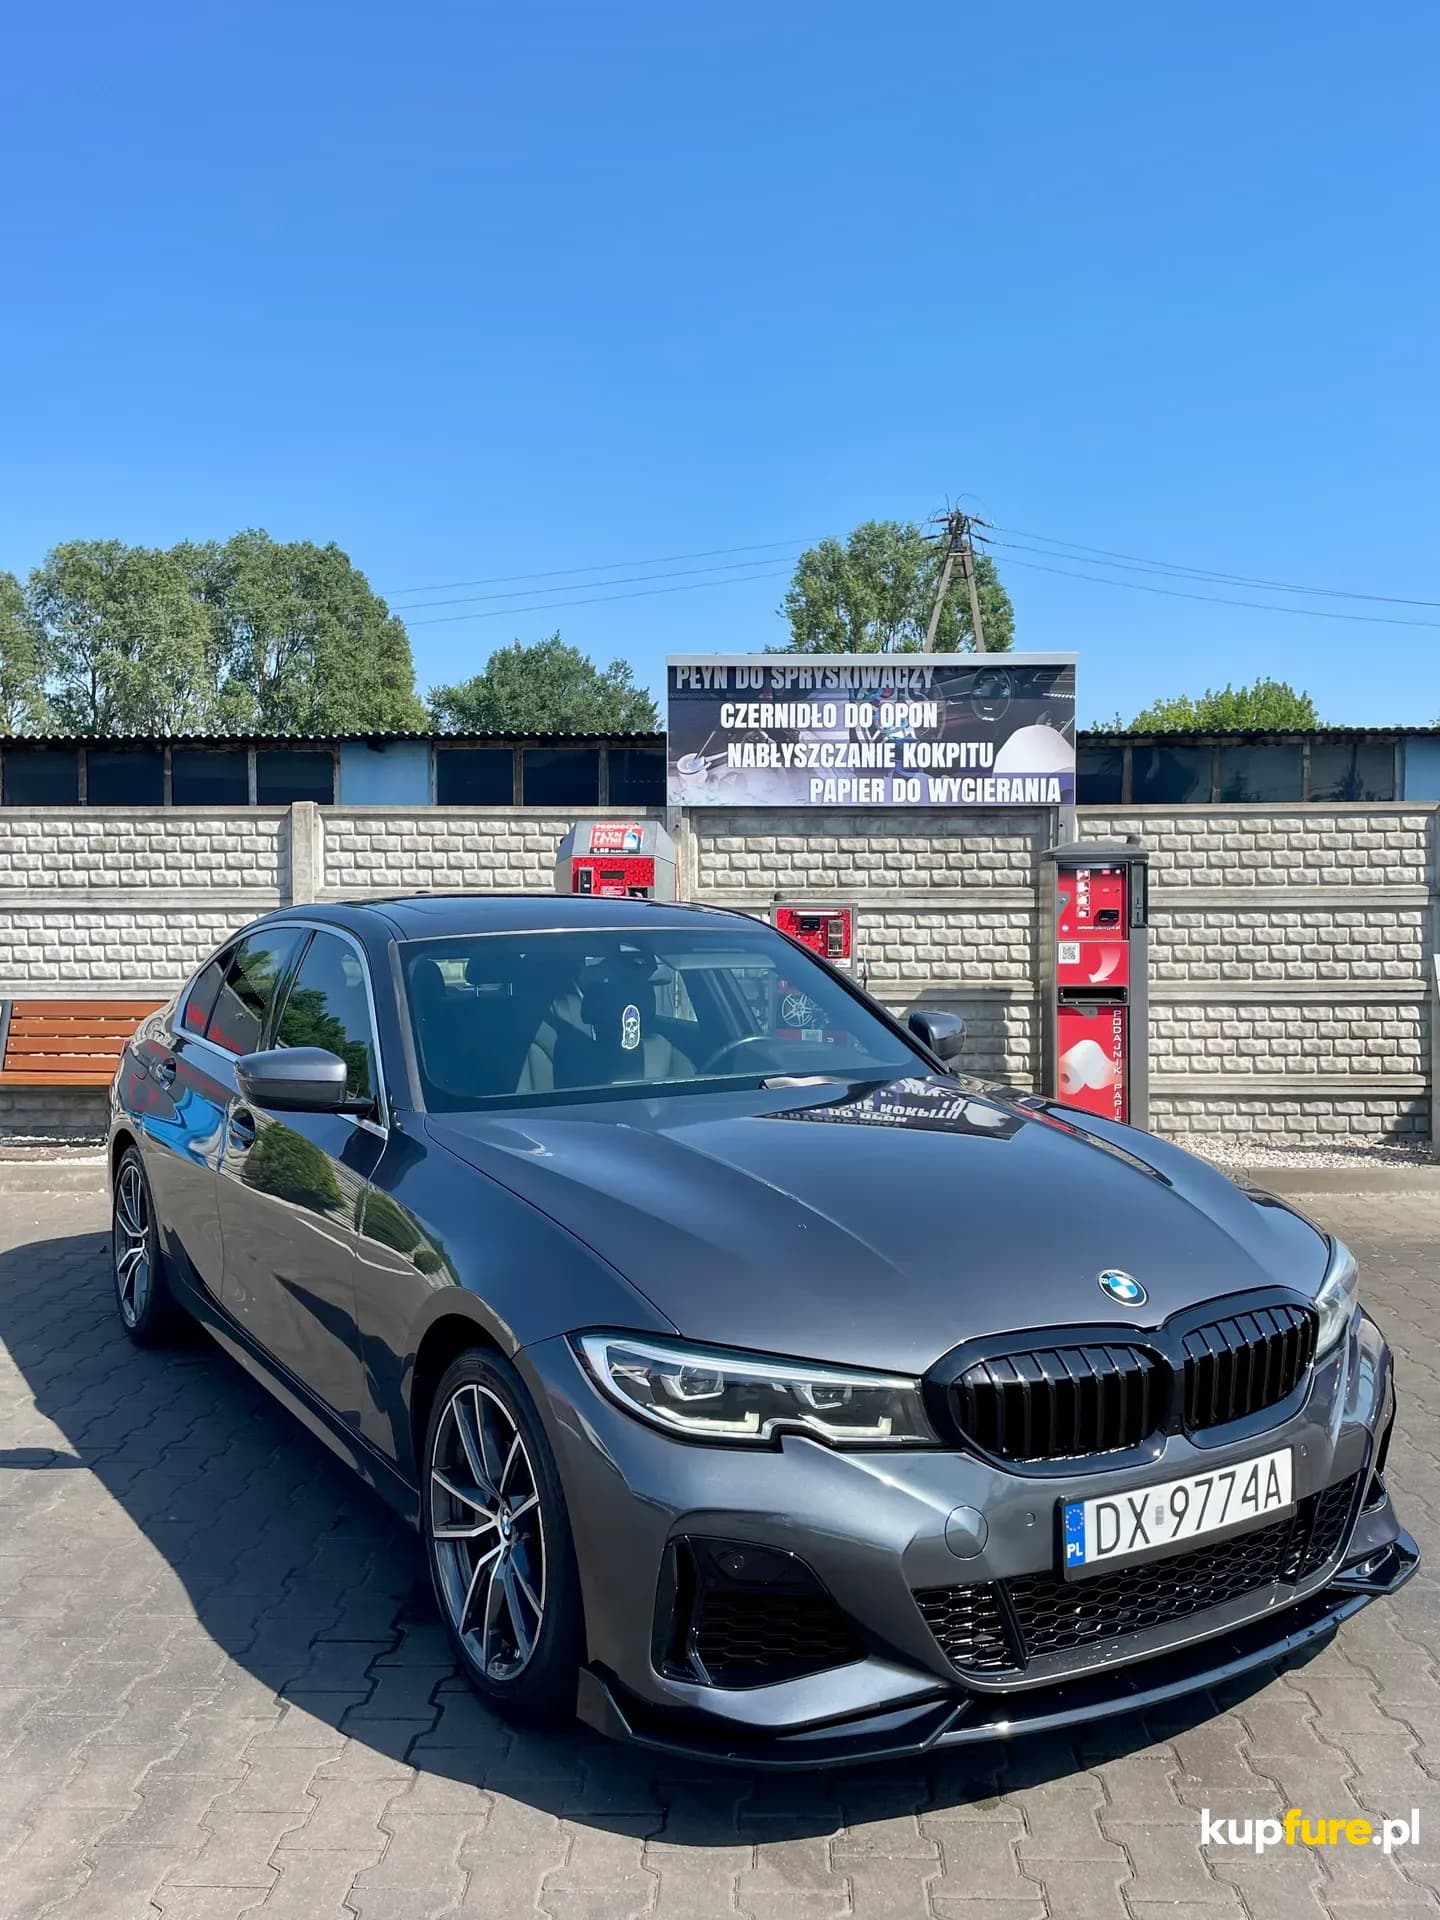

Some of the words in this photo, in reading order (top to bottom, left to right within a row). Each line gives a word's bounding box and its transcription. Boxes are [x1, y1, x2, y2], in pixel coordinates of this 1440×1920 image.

[676, 666, 728, 689] PŁYN
[735, 667, 764, 689] DO
[770, 667, 934, 689] SPRYSKIWACZY
[720, 702, 837, 728] CZERNIDŁO
[845, 703, 875, 728] DO
[880, 702, 938, 728] OPON
[727, 742, 896, 768] NABŁYSZCZANIE
[903, 742, 994, 768] KOKPITU
[810, 778, 885, 803] PAPIER
[892, 778, 922, 803] DO
[928, 777, 1061, 803] WYCIERANIA
[1112, 1010, 1122, 1074] PODAJNIK
[1096, 1492, 1151, 1556] DX
[1170, 1458, 1282, 1538] 9774A
[1066, 1543, 1084, 1559] PL
